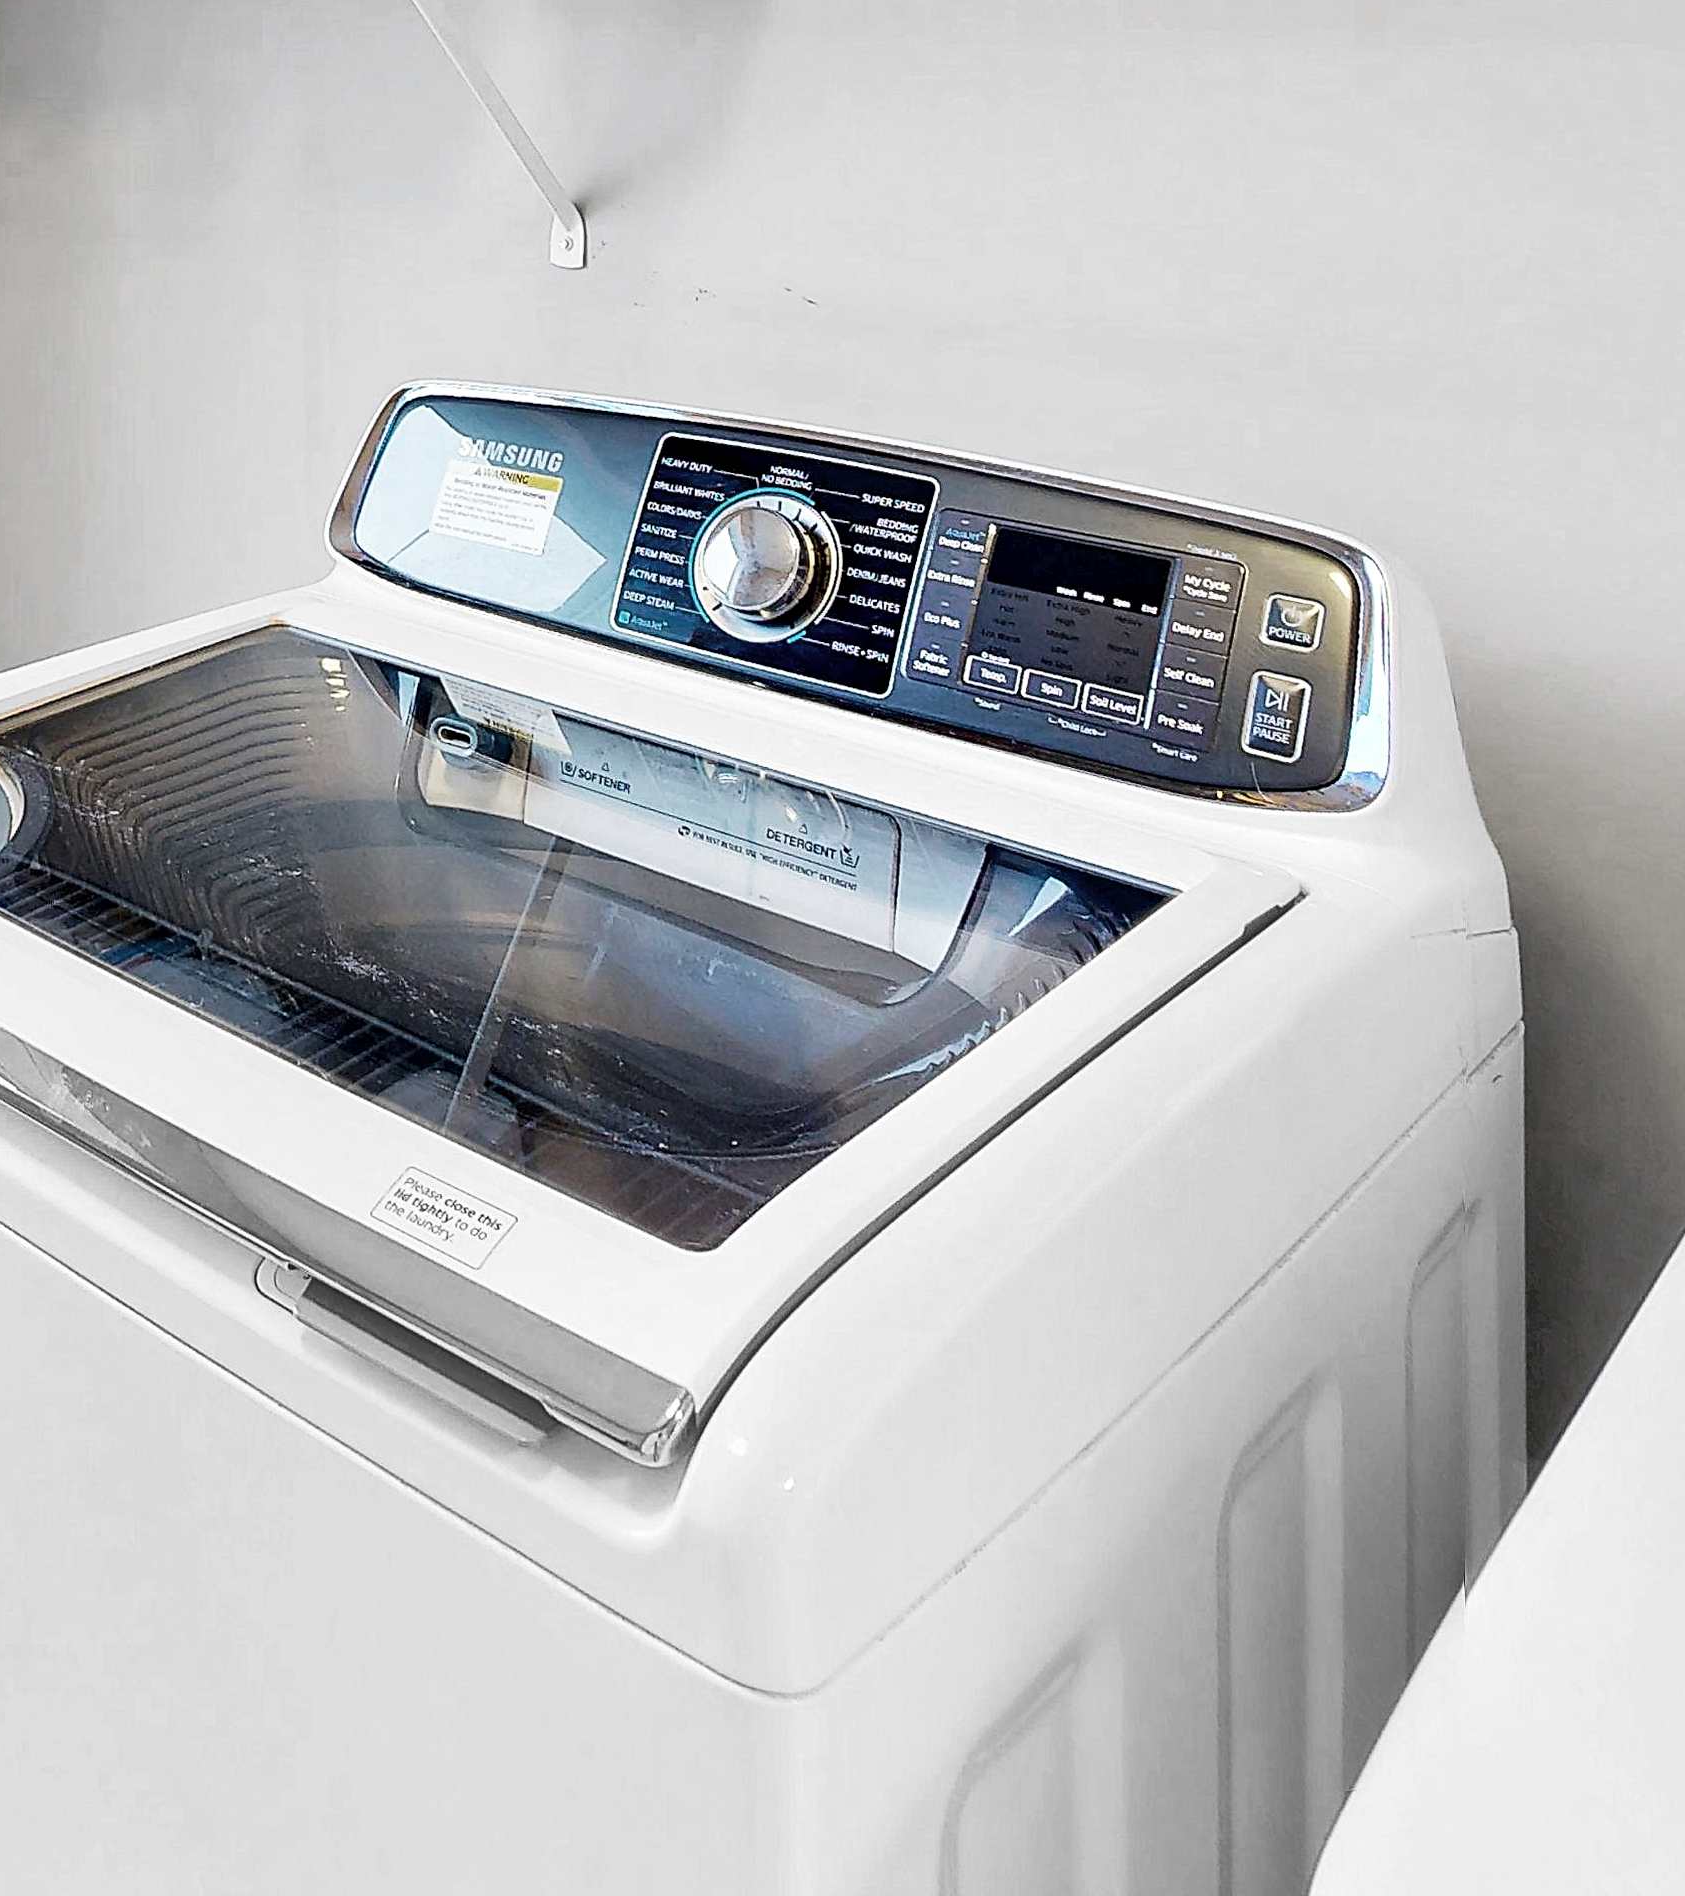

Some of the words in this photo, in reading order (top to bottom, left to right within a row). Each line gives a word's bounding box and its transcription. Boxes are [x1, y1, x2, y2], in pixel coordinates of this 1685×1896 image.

[457, 437, 564, 473] SAMSUNG
[661, 457, 688, 471] HEAVY
[690, 462, 713, 474] DUTY
[653, 481, 693, 496] BRILLIANT
[694, 487, 725, 502] WHITES
[776, 476, 813, 491] BEDDING
[862, 493, 892, 508] SUPER
[894, 499, 925, 513] SPEED
[641, 523, 677, 539] SANITIZE
[877, 517, 919, 534] BEDDING
[635, 546, 658, 559] PERM
[658, 551, 685, 565] PRESS
[853, 543, 883, 557] QUICK
[884, 550, 912, 564] WASH
[629, 568, 658, 583] ACTIVE
[659, 576, 684, 588] WEAR
[927, 569, 951, 583] Extra
[1185, 574, 1201, 588] My
[1202, 578, 1231, 592] Cycle
[623, 591, 646, 602] DEEP
[646, 596, 675, 610] STEAM
[850, 594, 901, 614] DELICATES
[871, 625, 894, 638] SPIN
[941, 615, 962, 629] Plus
[1171, 622, 1202, 639] Delay
[1203, 629, 1224, 643] End
[1268, 626, 1311, 644] POWER
[920, 649, 949, 665] Fabric
[913, 659, 951, 677] Softener
[1164, 666, 1184, 681] Self
[1185, 671, 1215, 688] Clean
[1040, 682, 1063, 697] Spin
[1089, 694, 1109, 709] Soil
[1110, 700, 1137, 716] Level
[1158, 713, 1175, 728] Pre
[1177, 717, 1204, 735] Soak
[1255, 713, 1293, 729] START
[1252, 728, 1290, 745] PAUSE
[577, 767, 631, 794] SOFTENER
[766, 827, 837, 861] DETERGENT
[404, 1177, 444, 1203] Please
[444, 1197, 477, 1218] close
[477, 1214, 503, 1232] this
[384, 1200, 405, 1217] the
[406, 1210, 455, 1243] laundry.
[393, 1188, 412, 1203] lid
[412, 1196, 454, 1224] tightly
[454, 1218, 469, 1232] to
[469, 1226, 488, 1241] do
